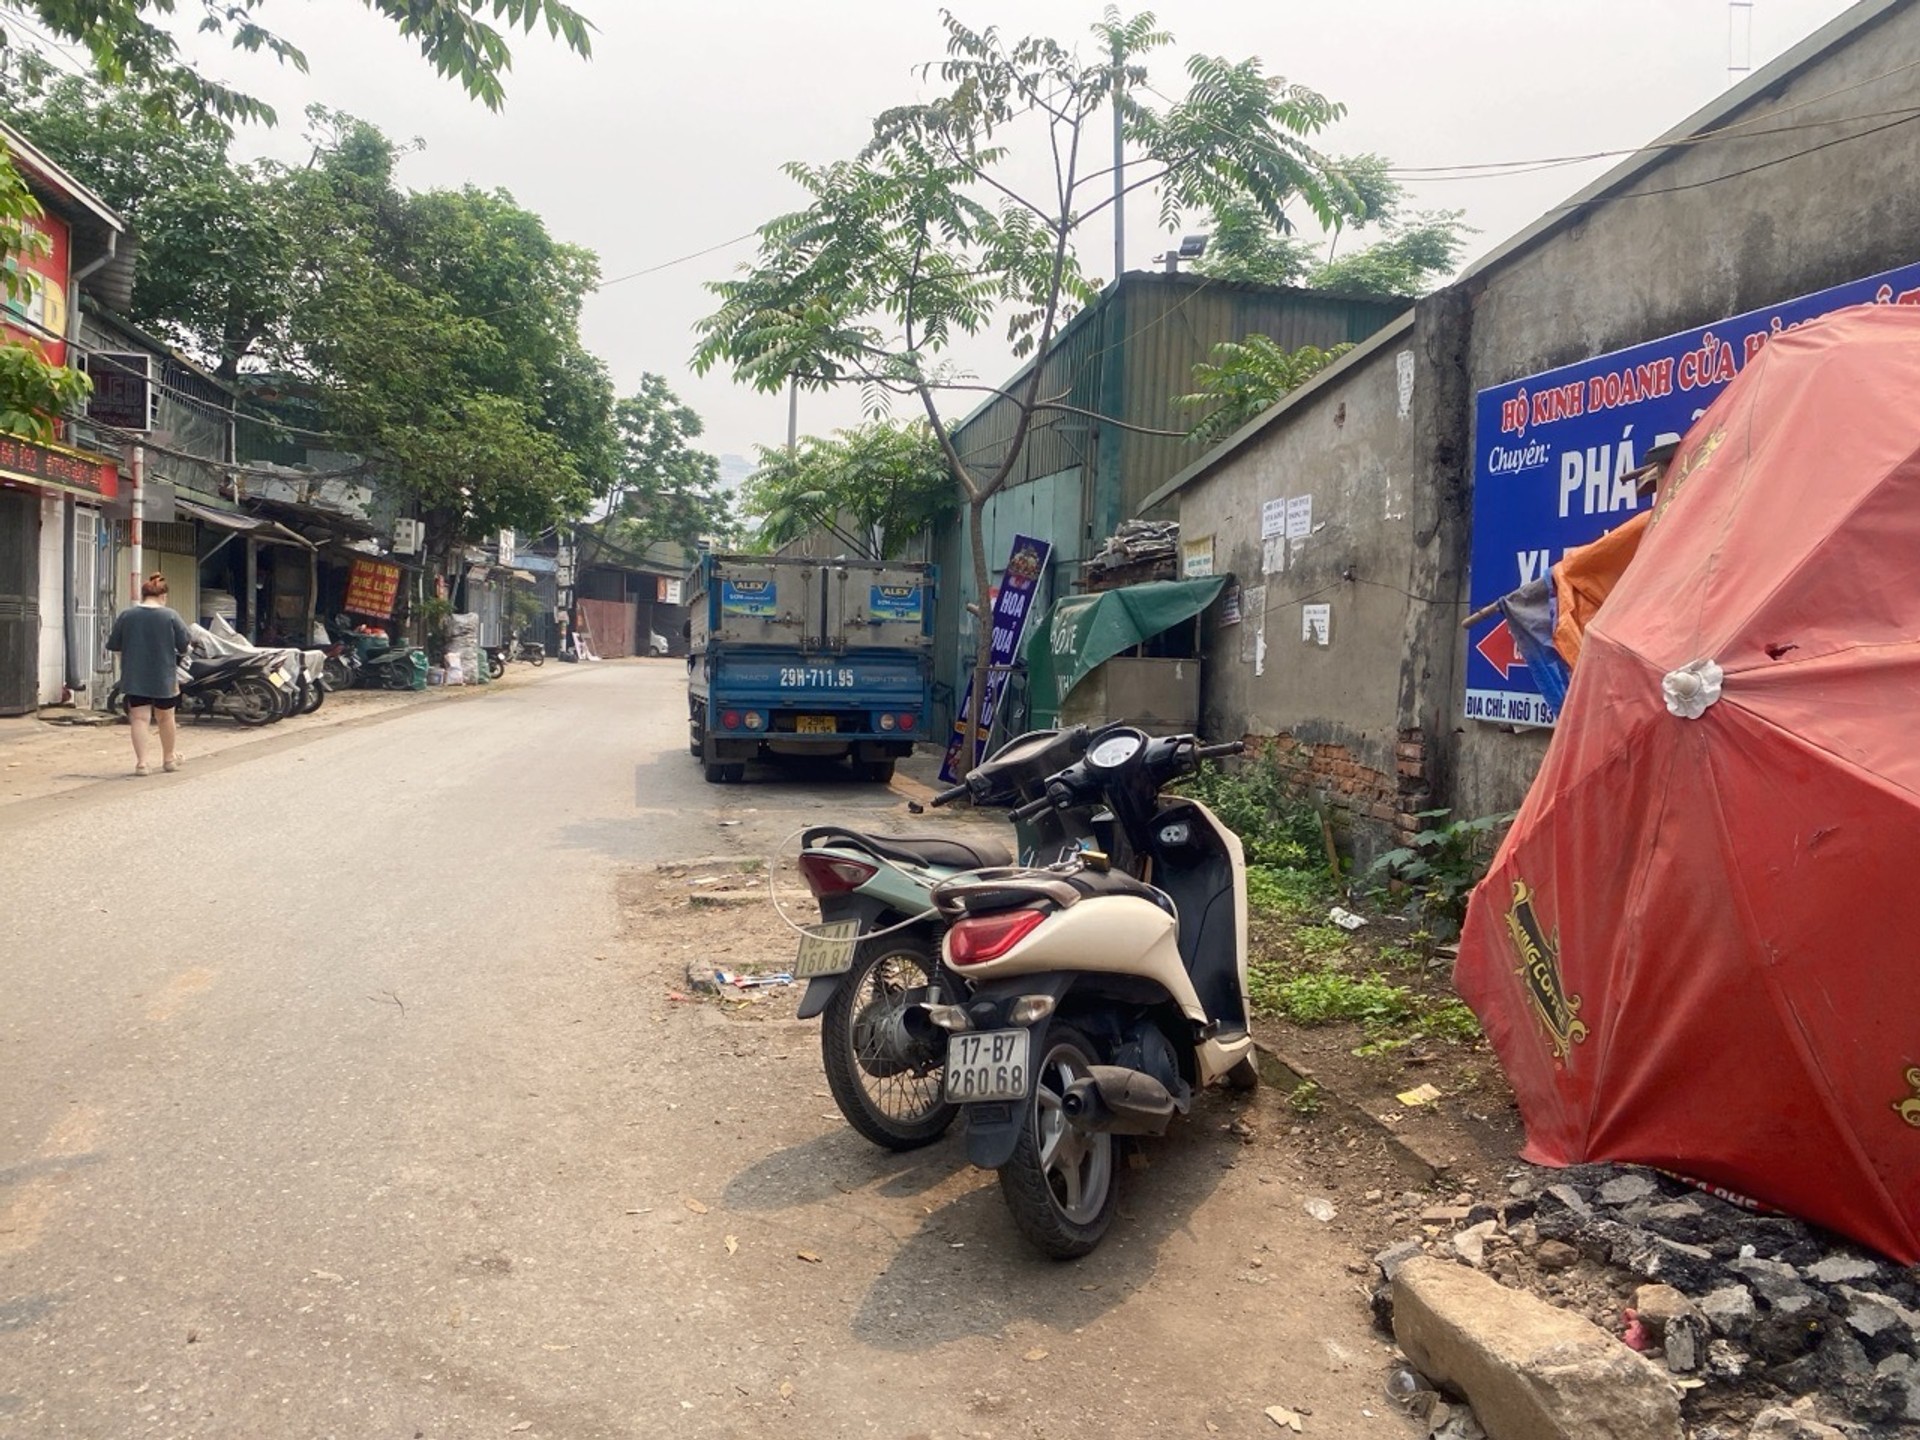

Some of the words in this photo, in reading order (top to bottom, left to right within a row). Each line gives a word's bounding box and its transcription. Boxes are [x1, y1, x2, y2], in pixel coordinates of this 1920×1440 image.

[1502, 388, 1530, 438] HỘ
[1532, 380, 1585, 427] KINH
[1588, 358, 1675, 413] DOANH
[1679, 332, 1737, 391] CỬA
[1489, 440, 1550, 474] Chuyên:
[1559, 425, 1637, 518] PHÁ
[355, 560, 375, 573] THU
[736, 581, 764, 590] ALEX
[883, 587, 909, 596] ALEX
[1000, 590, 1026, 618] HOA
[780, 668, 854, 687] 29H-711.95
[807, 716, 825, 725] 29H
[1467, 696, 1483, 719] ĐỊA
[1485, 692, 1506, 719] CHỈ:
[1508, 697, 1531, 722] NGÕ
[961, 1034, 1016, 1065] 17-B7
[951, 1065, 1022, 1097] 260.68
